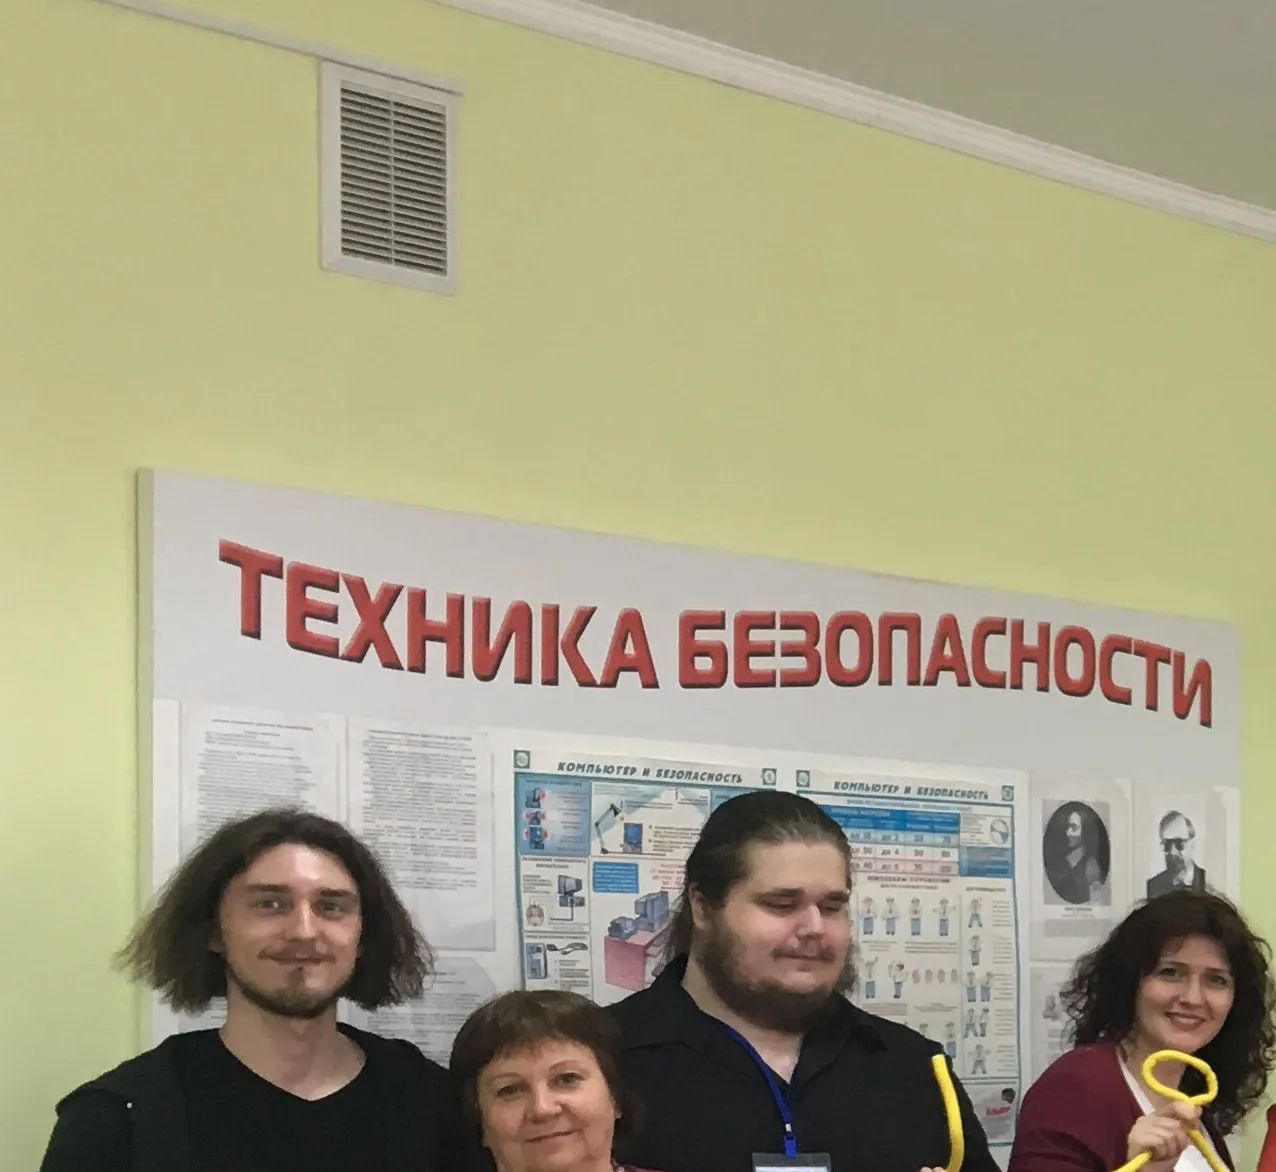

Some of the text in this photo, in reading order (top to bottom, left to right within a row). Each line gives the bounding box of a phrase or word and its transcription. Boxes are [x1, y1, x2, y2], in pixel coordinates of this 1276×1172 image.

[219, 538, 1212, 728] ТЕХНИКА БЕЗОПАСНОСТИ
[557, 762, 743, 786] КОМПЬЮТЕР И БЕЗОПАСНОСТЬ
[834, 780, 900, 795] КОМПЬЮТЕР
[917, 786, 989, 800] БЕЗОПАСНОСТЬ
